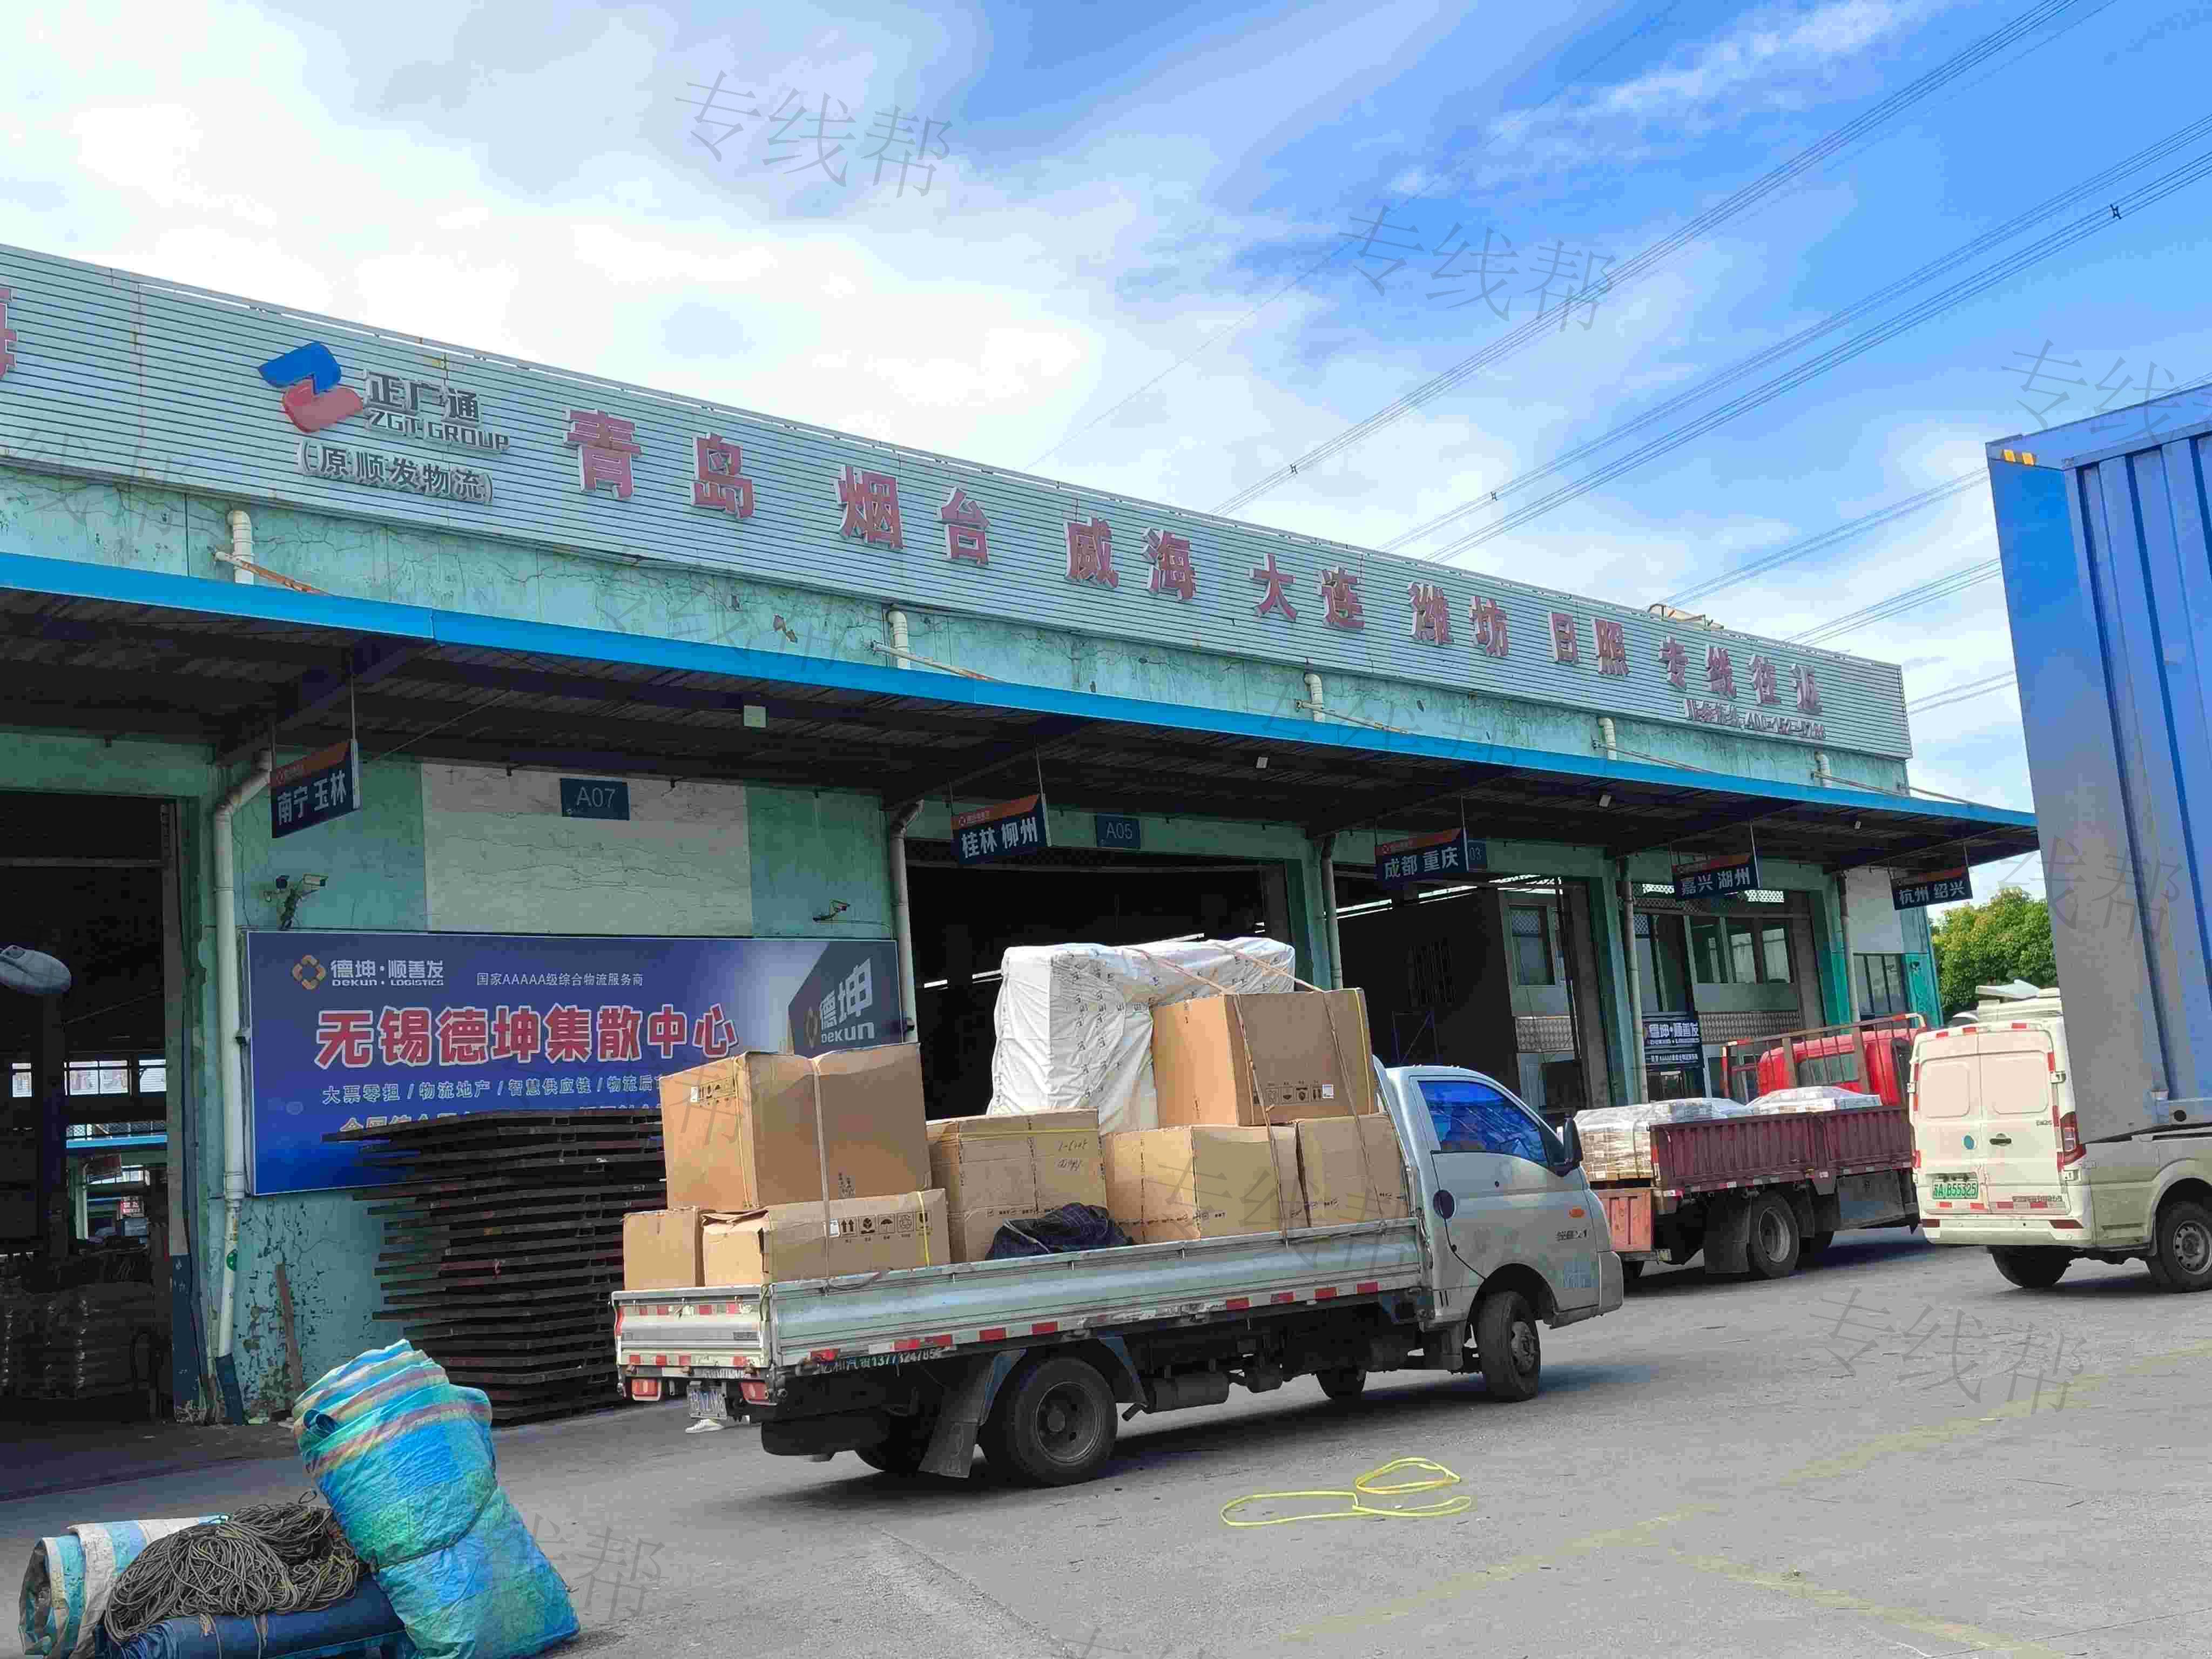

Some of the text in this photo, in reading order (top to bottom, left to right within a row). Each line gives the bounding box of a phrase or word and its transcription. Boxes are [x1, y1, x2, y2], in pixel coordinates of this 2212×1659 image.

[423, 421, 510, 450] GROUP
[563, 409, 755, 520] 青岛
[834, 465, 990, 566] 烟台
[1063, 516, 1197, 601] 威海
[1249, 552, 1365, 630] 大连
[1547, 611, 1629, 676] 日照
[277, 786, 308, 826] 南宁
[313, 769, 347, 812] 玉林
[576, 786, 615, 808] A07
[961, 816, 1038, 858] 桂林 柳州
[1384, 846, 1459, 880] 成都 重庆
[1717, 866, 1750, 889] 湖州
[1899, 880, 1965, 905] 杭州 绍兴
[476, 972, 644, 987] 国家AAAAA级综合物流服务商
[820, 957, 873, 1030] 德坤
[314, 1002, 738, 1069] 无锡德坤集散中心
[322, 1084, 401, 1105] 大票零担
[419, 1080, 491, 1100] 物流地产
[508, 1076, 592, 1097] 智慧供应链
